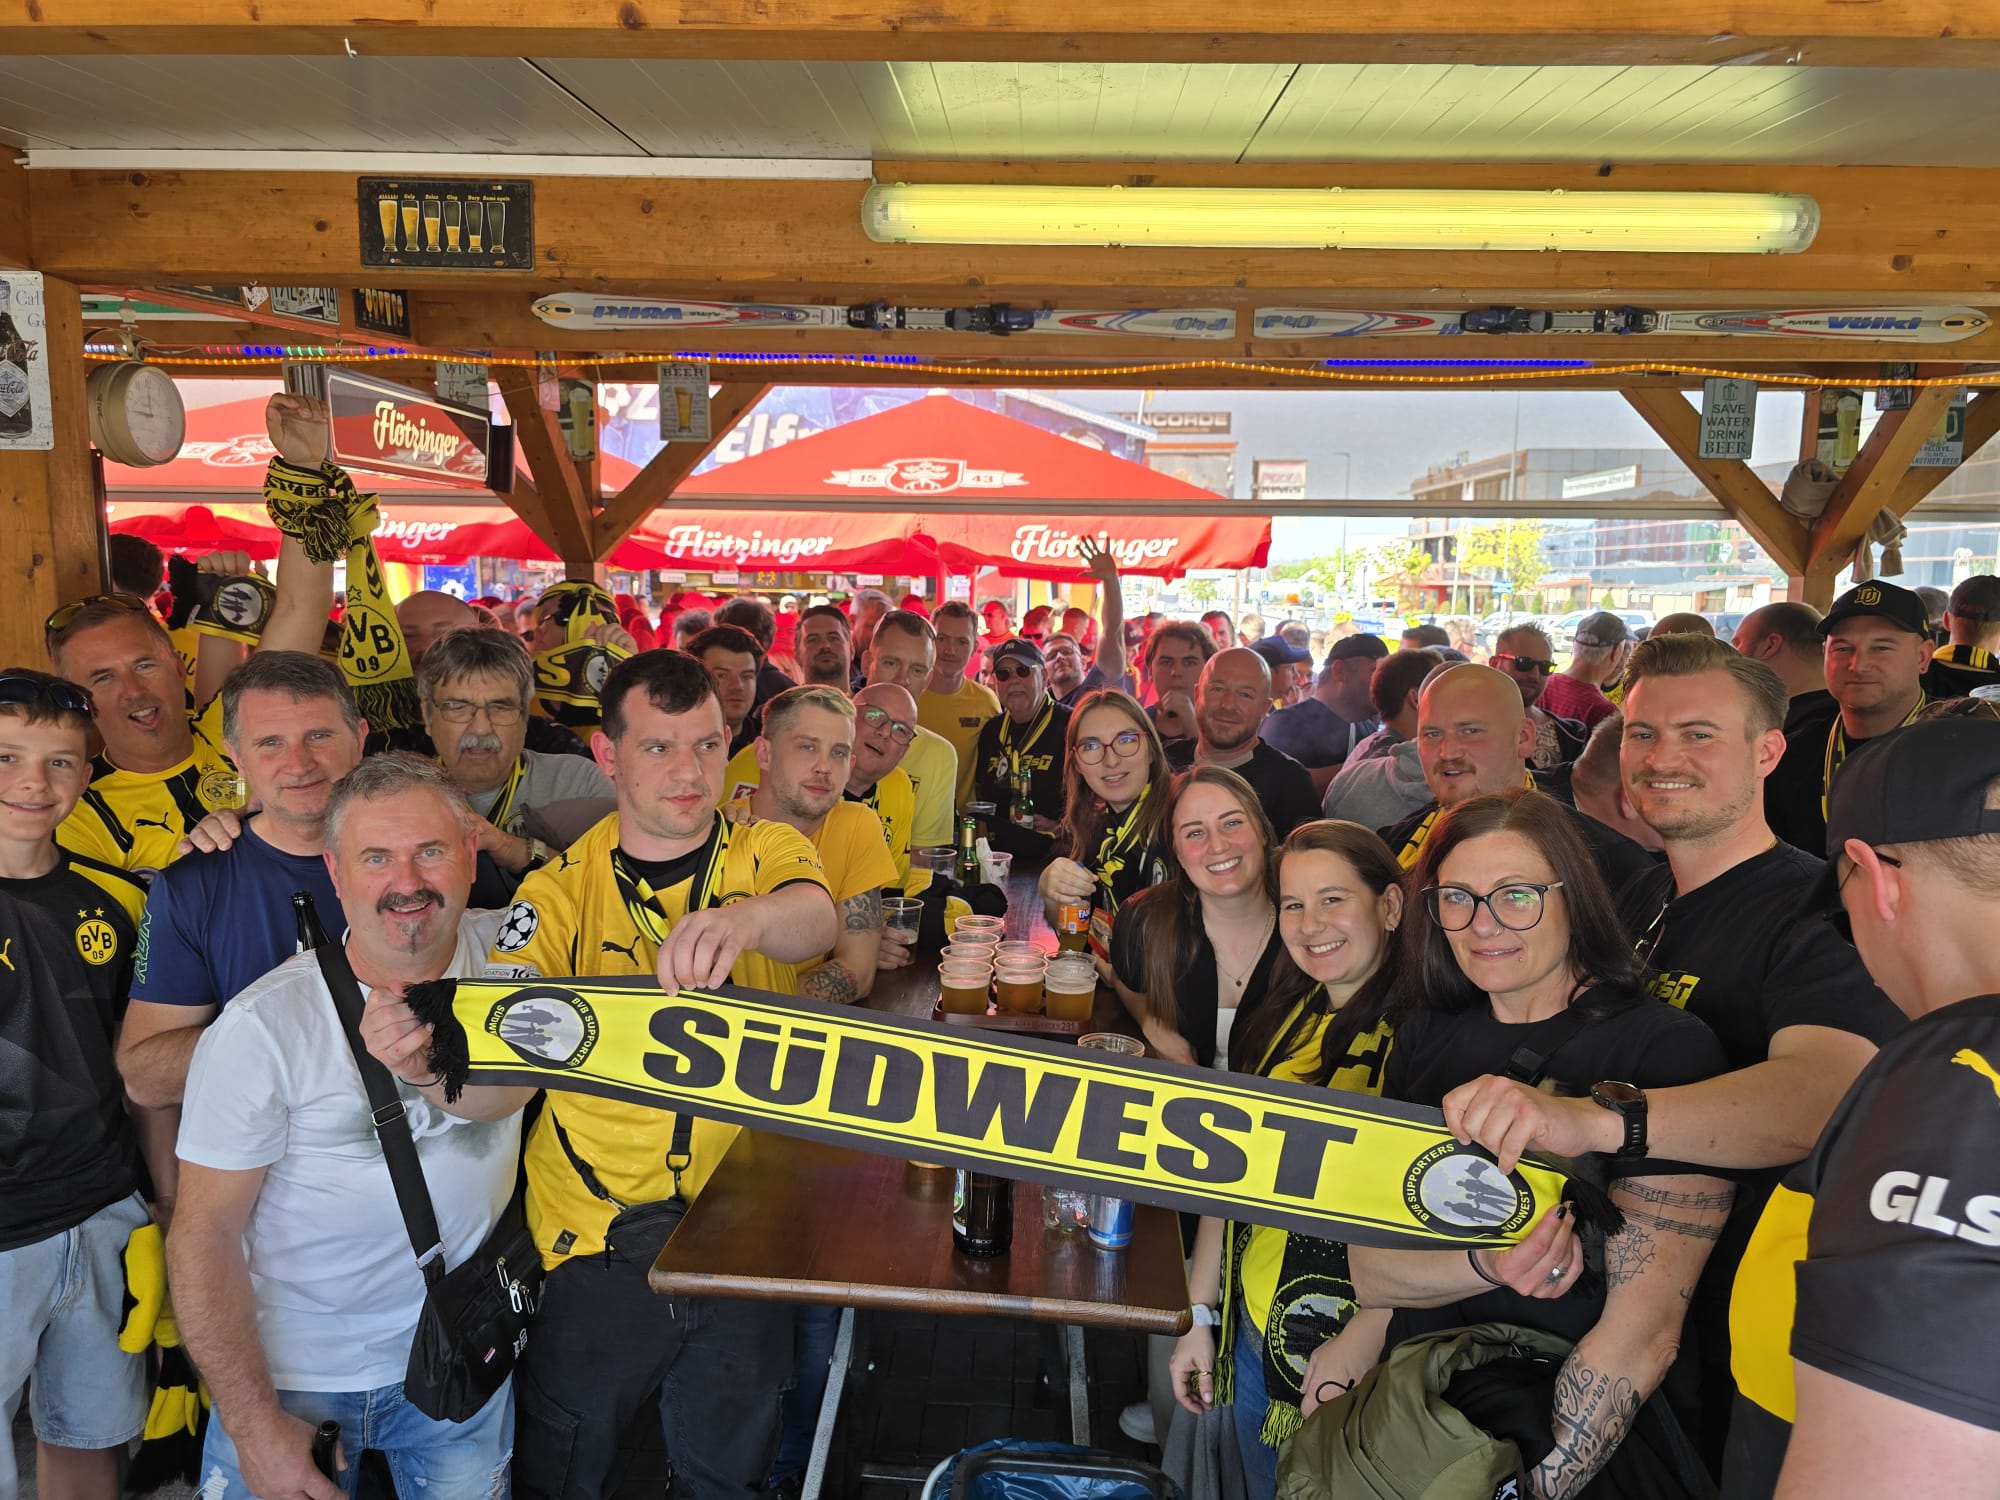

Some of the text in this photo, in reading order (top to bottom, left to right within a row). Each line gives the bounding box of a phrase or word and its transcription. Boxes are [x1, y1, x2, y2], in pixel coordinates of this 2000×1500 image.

[663, 367, 704, 377] BEER
[1712, 403, 1746, 414] SAVE
[1706, 416, 1751, 427] WATER
[373, 400, 460, 466] Flötzinger
[1707, 429, 1746, 440] DRINK
[1704, 441, 1747, 454] BEER
[971, 474, 993, 483] 43
[664, 525, 834, 565] Flötzinger
[356, 655, 379, 673] 09
[80, 925, 112, 952] BVB
[93, 950, 104, 960] 09
[567, 997, 597, 1066] BVB SUPPORTE
[643, 1006, 1358, 1200] SÜDWEST
[1406, 1143, 1455, 1222] BVB SUPPORTERS
[1869, 1170, 2000, 1246] GLS
